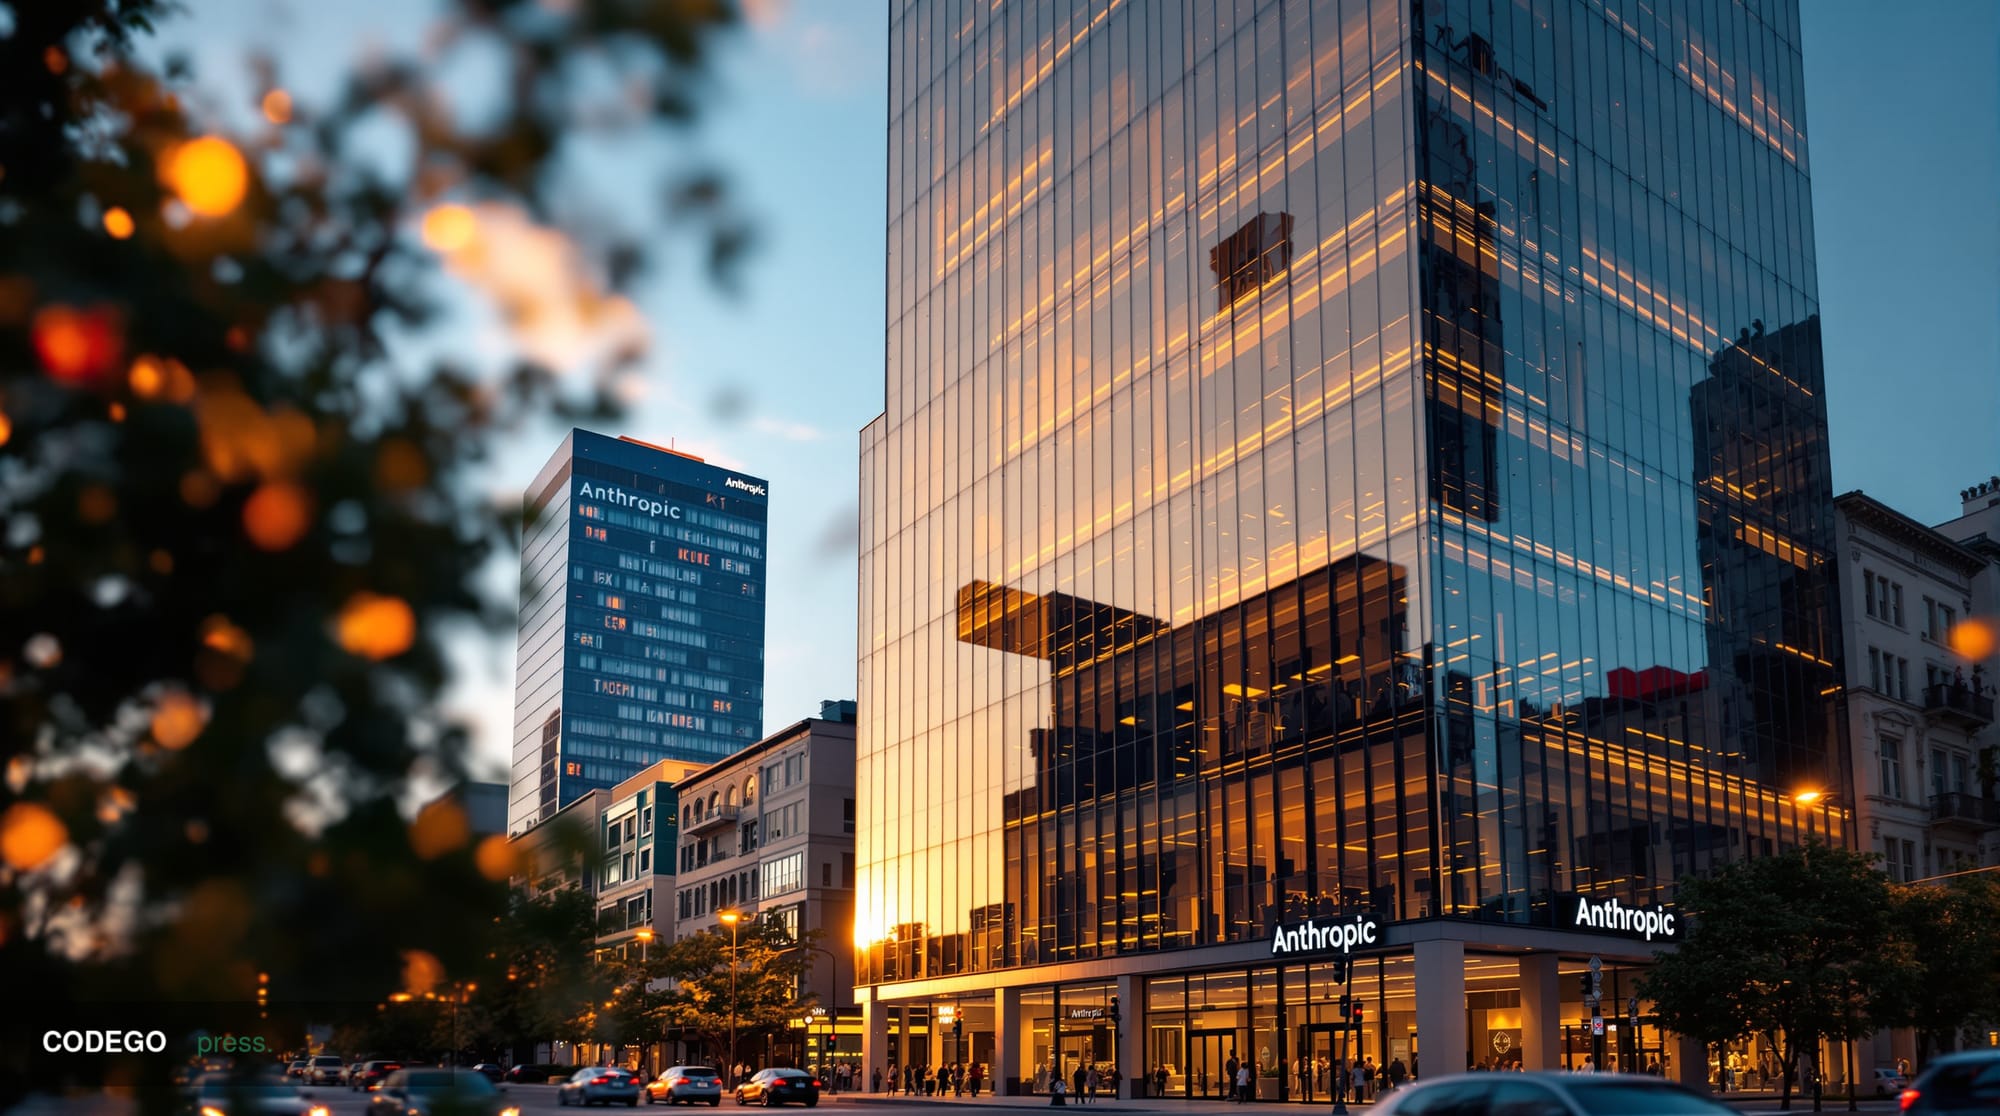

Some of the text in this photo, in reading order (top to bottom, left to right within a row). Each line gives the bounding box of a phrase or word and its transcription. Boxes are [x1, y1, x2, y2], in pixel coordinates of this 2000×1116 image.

[579, 482, 680, 519] Anthropic
[1272, 915, 1376, 953] Anthropic
[1575, 897, 1675, 941] Anthropic
